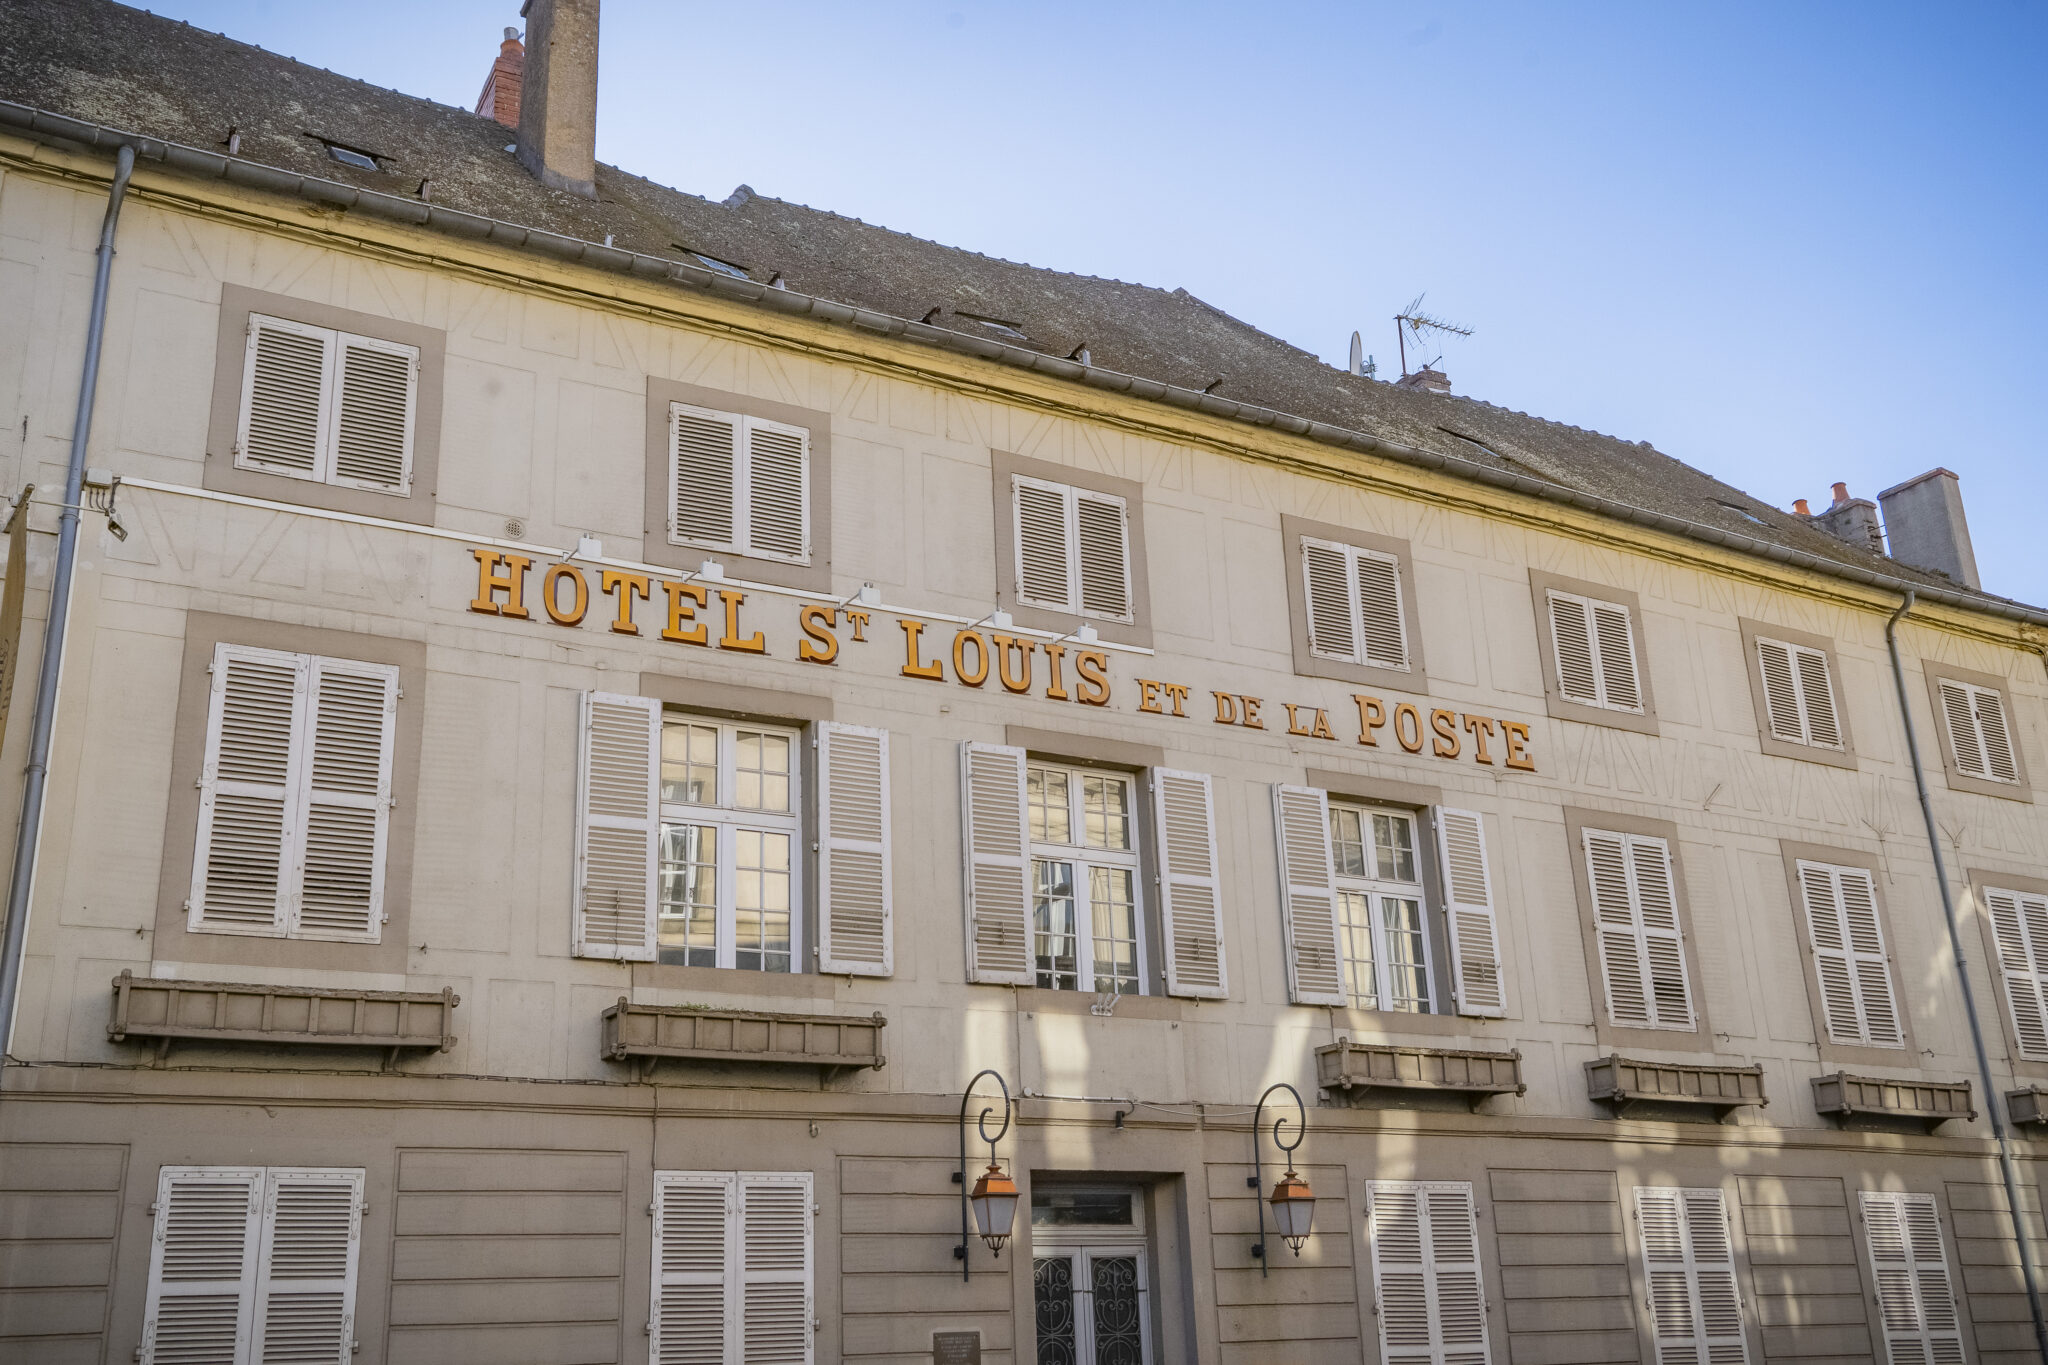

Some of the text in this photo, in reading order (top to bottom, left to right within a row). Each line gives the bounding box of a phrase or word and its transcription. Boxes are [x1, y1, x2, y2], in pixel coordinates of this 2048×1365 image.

[471, 550, 765, 654] HOTEL
[901, 619, 1110, 706] LOUIS
[1138, 679, 1188, 717] ET
[1213, 691, 1264, 729] DE
[1287, 703, 1336, 740] LA
[1355, 694, 1535, 771] POSTE
